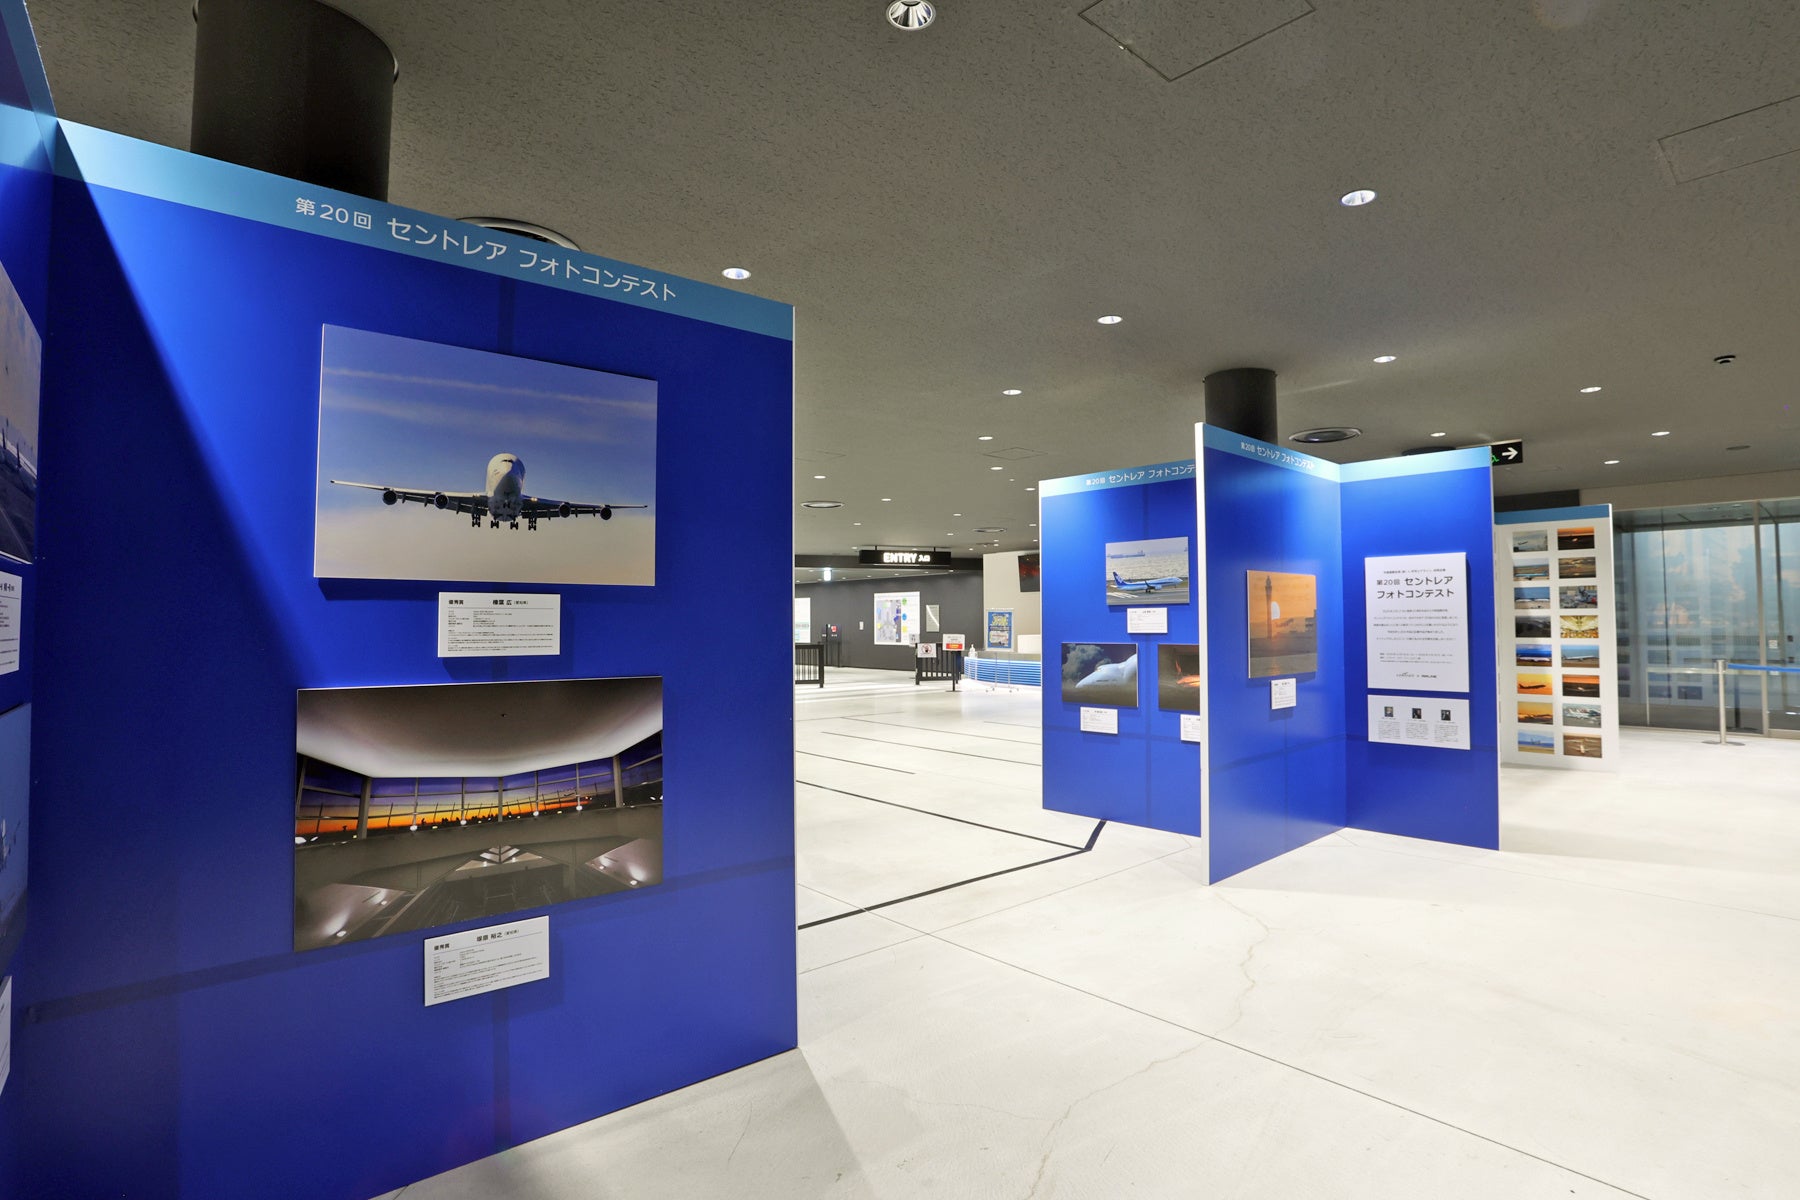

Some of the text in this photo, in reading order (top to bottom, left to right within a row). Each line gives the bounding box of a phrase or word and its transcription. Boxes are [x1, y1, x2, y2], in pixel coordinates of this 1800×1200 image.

[296, 197, 677, 302] 第20回 セントレア フォトコンテスト
[1109, 471, 1145, 484] セントレア
[883, 552, 917, 564] ENTRY
[1404, 576, 1453, 586] セントレア
[1376, 588, 1455, 599] フォトコンテスト
